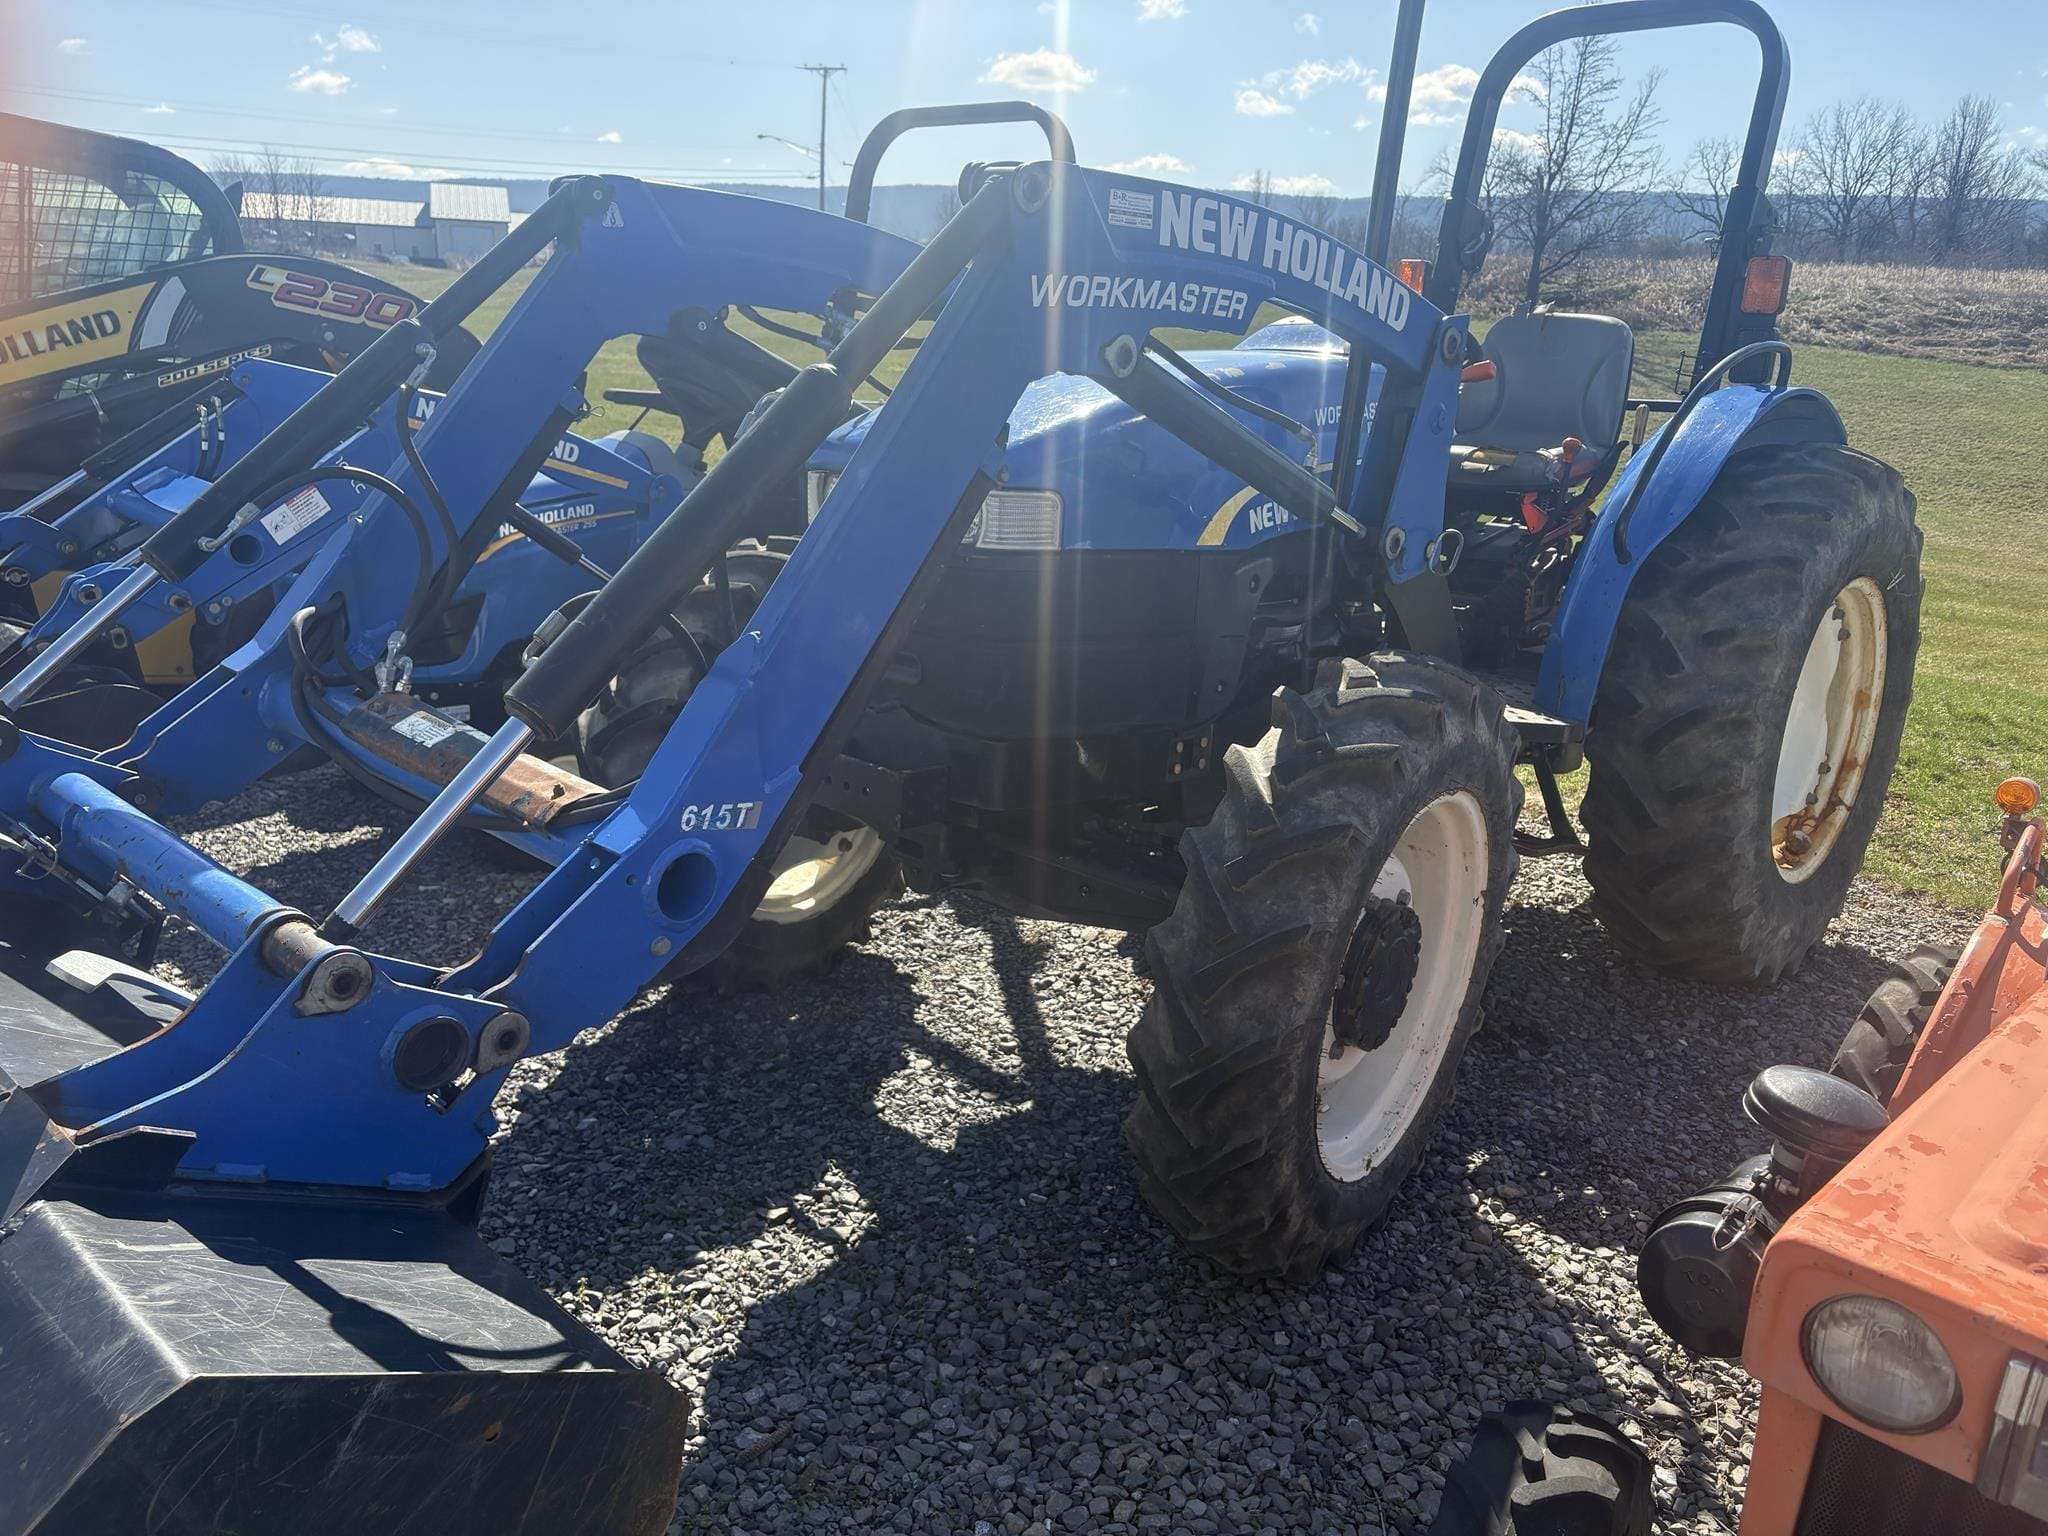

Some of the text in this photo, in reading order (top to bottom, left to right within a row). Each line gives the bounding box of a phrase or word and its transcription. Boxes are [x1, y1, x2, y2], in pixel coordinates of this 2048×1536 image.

[1159, 190, 1410, 333] NEW HOLLAND
[1031, 273, 1248, 321] WORKMASTER
[157, 344, 272, 387] 200 SERIES
[535, 504, 594, 524] HOLLAND
[1249, 501, 1289, 534] NEW
[680, 802, 754, 832] 615T
